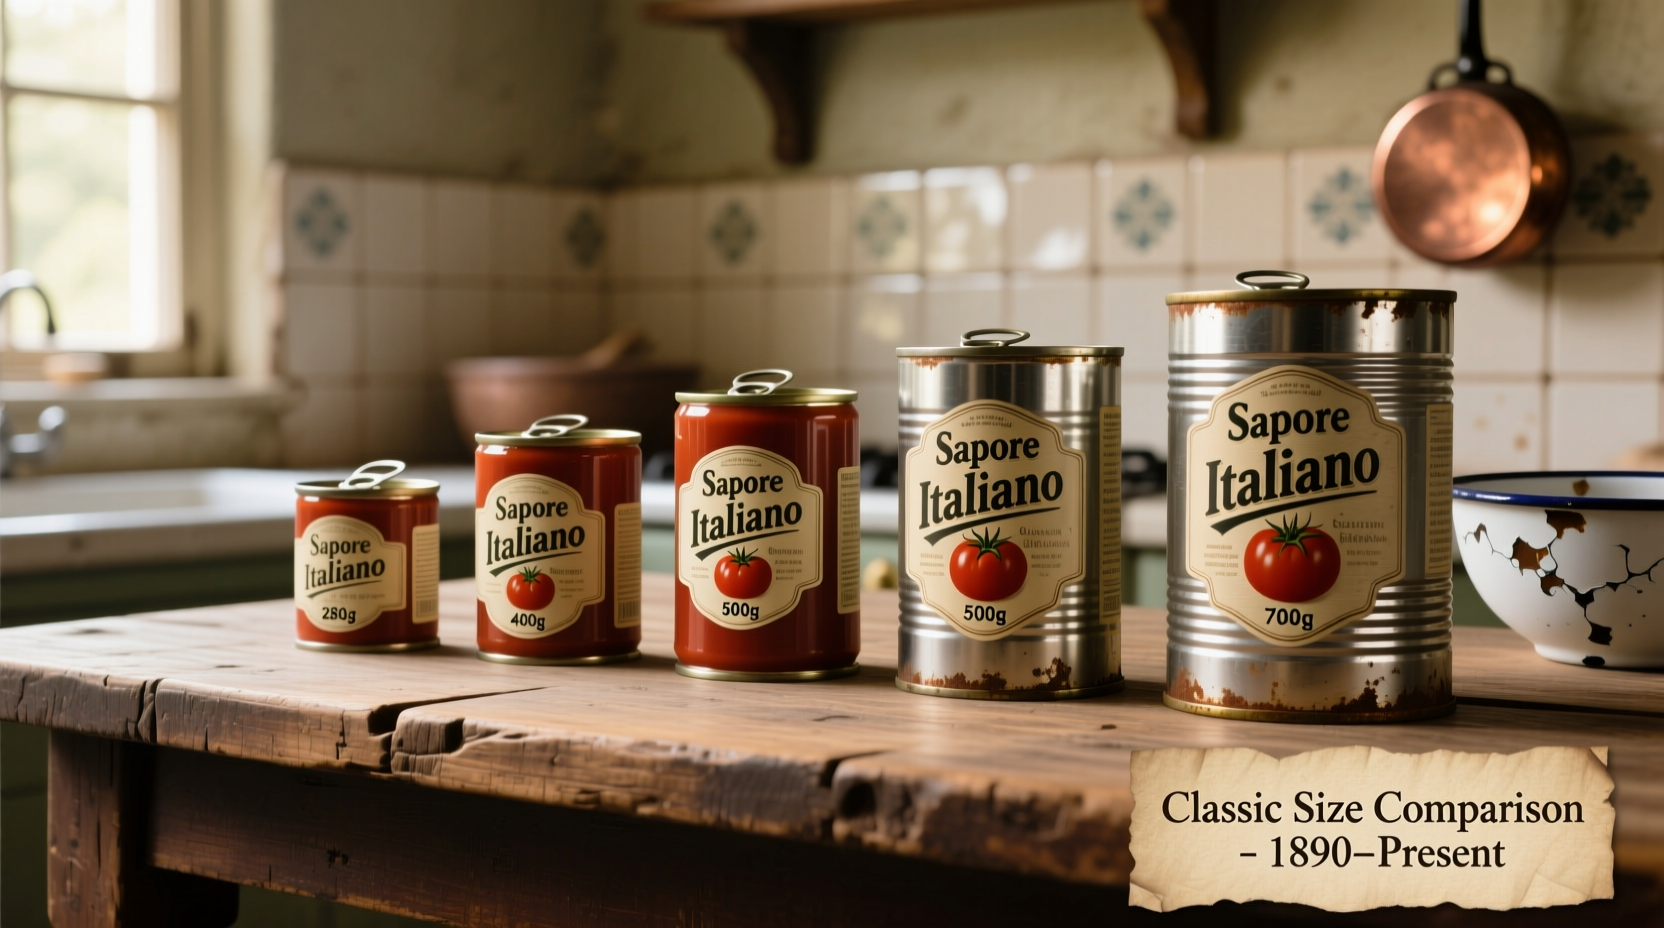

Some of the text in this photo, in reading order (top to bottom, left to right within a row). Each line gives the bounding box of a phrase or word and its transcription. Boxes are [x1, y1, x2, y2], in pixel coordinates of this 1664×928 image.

[1228, 402, 1350, 445] Sapore
[935, 431, 1040, 470] Sapore
[702, 469, 784, 500] Sapore
[1205, 448, 1380, 517] Italiano
[495, 496, 568, 524] Sapore
[918, 470, 1064, 530] Italiano
[690, 501, 803, 548] Italiano
[310, 534, 371, 559] Sapore
[486, 525, 585, 565] Italiano
[305, 559, 386, 590] Italiano
[322, 607, 356, 624] 280g
[510, 613, 546, 631] 400g
[722, 602, 760, 621] 500g
[963, 605, 1007, 626] 500g
[1264, 607, 1314, 631] 700g
